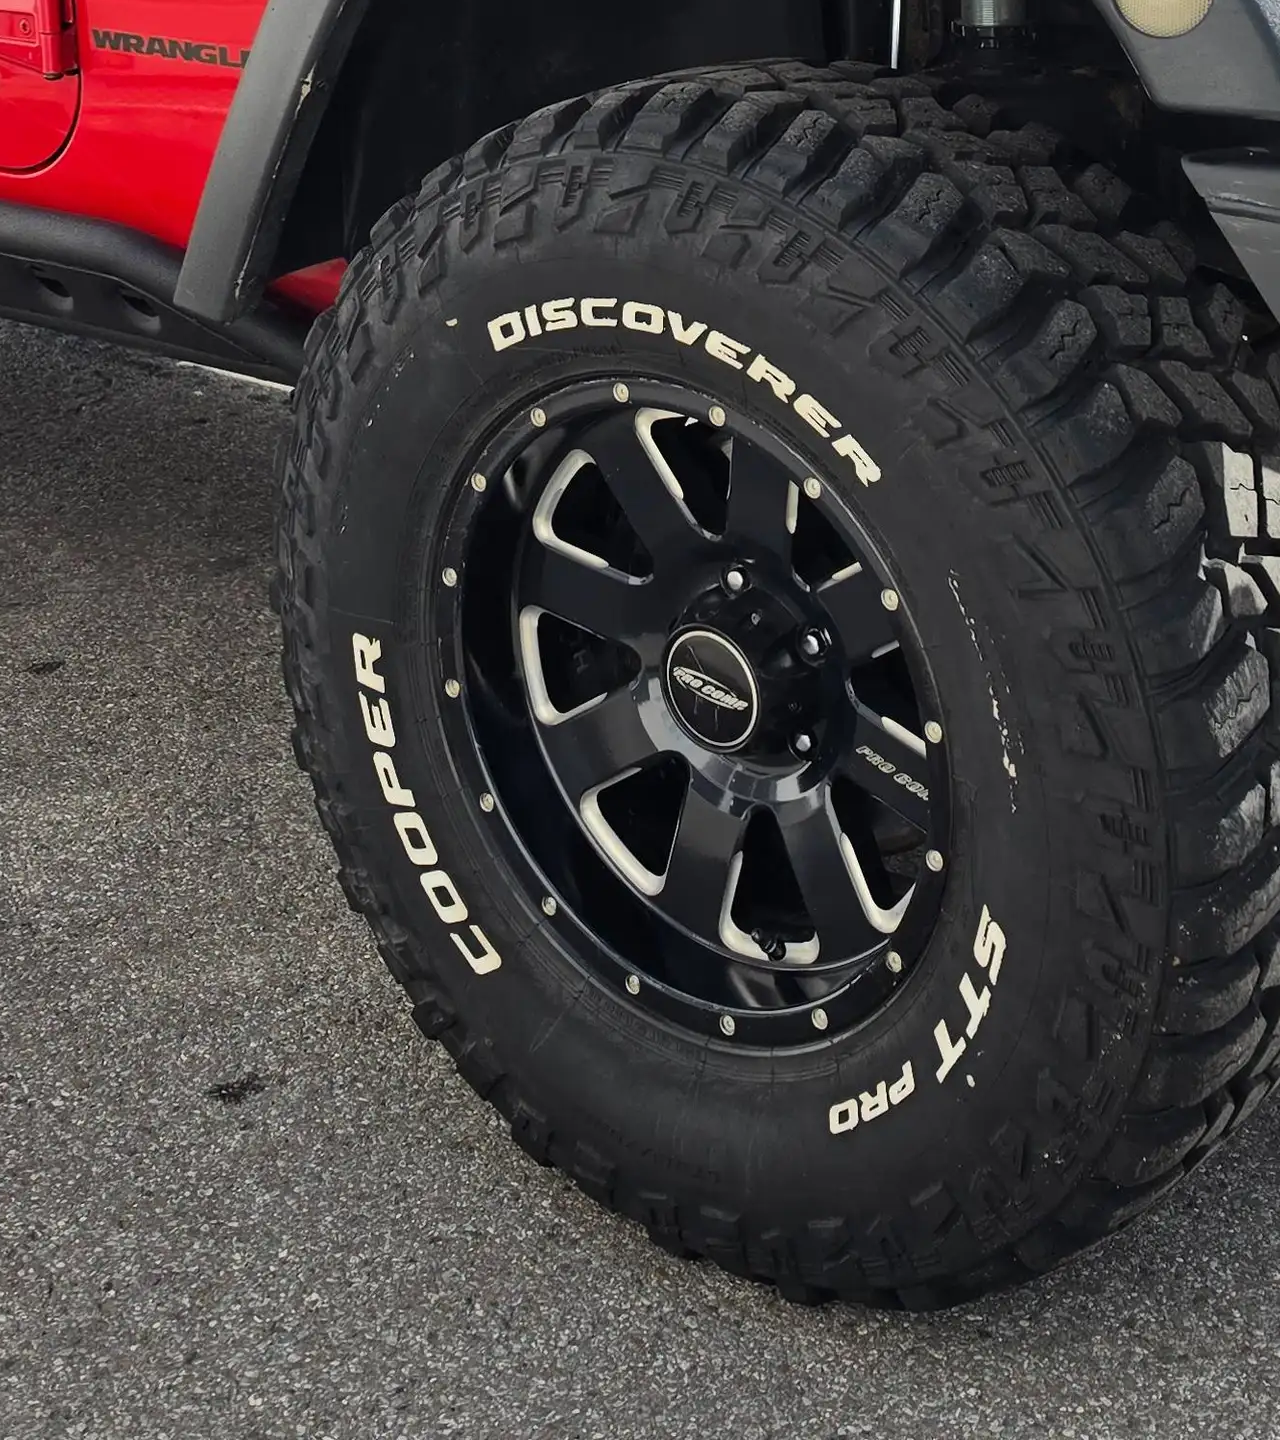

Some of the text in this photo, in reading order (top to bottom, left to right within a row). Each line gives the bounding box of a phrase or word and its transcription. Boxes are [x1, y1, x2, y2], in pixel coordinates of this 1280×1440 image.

[486, 297, 882, 488] DISCOVERER
[672, 668, 749, 711] PRO COMP
[352, 632, 502, 975] COOPER
[855, 745, 897, 774] PRO
[933, 904, 1008, 1084] STT
[828, 1060, 916, 1136] PRO
